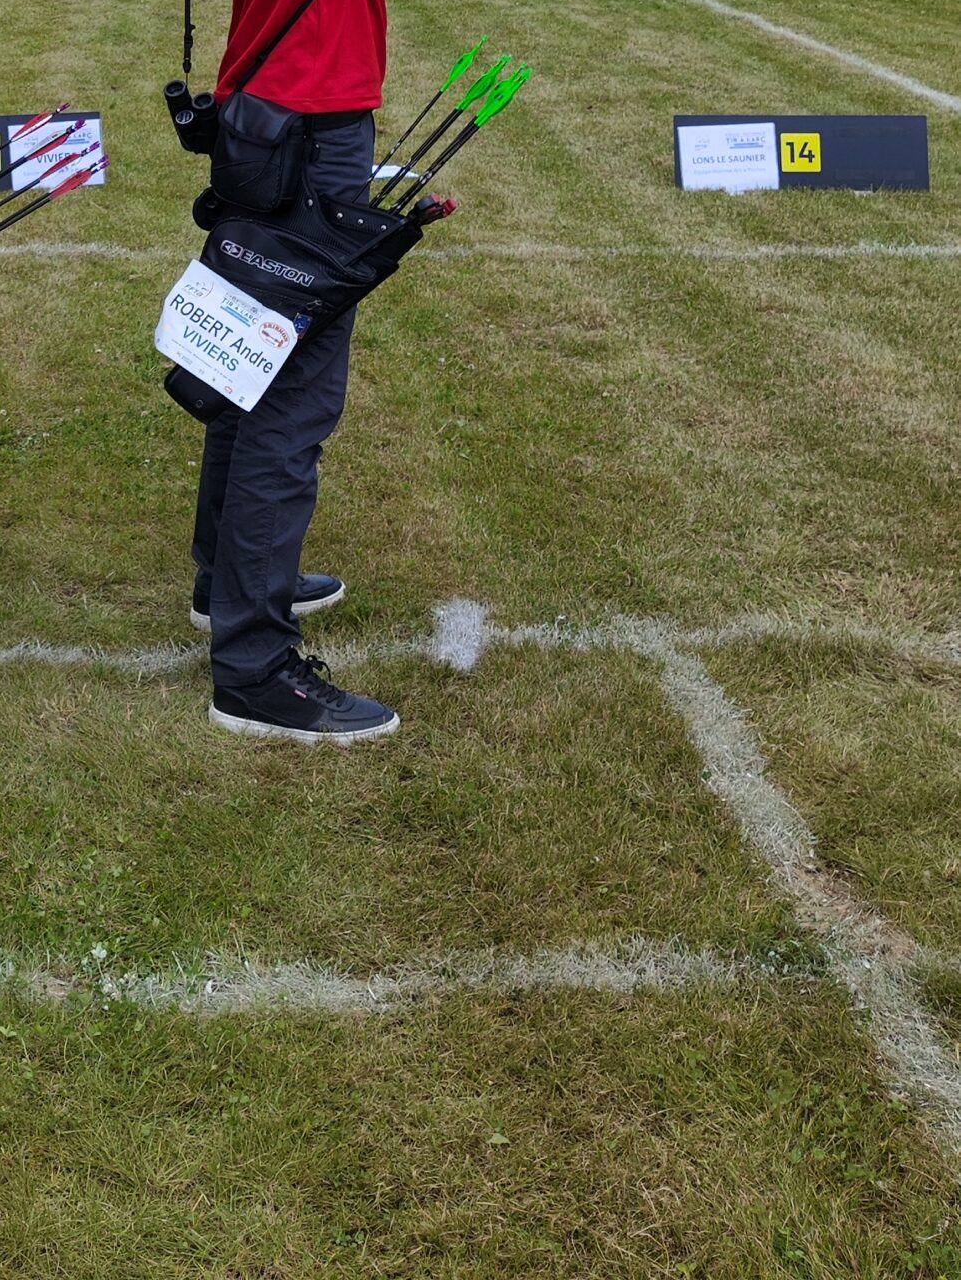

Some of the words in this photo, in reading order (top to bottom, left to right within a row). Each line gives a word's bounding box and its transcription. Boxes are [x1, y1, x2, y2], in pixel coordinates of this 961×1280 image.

[692, 156, 715, 165] LONS
[717, 155, 726, 163] LE
[728, 154, 766, 163] SAUNIER
[786, 141, 815, 163] 14
[240, 249, 315, 287] EASTON
[169, 294, 233, 341] ROBERT
[229, 337, 273, 374] Andre
[183, 326, 239, 371] VIVIERS
